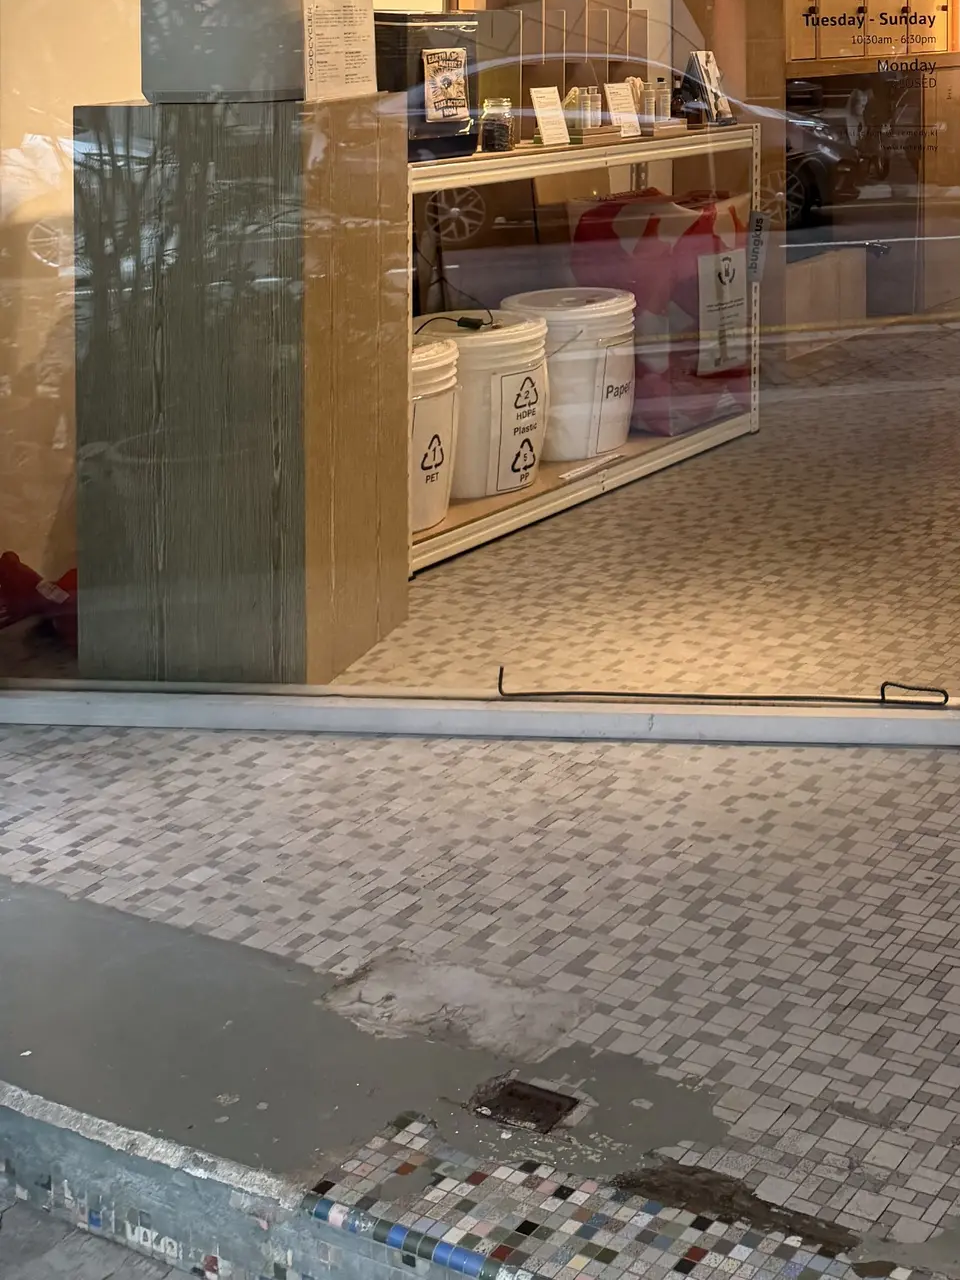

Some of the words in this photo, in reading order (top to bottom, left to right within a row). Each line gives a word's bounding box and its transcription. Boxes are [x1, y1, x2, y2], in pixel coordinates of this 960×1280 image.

[802, 13, 865, 29] Tuesday
[879, 12, 936, 28] Sunday
[851, 35, 892, 45] 10:30am
[900, 34, 937, 46] 6:30pm
[877, 58, 937, 74] Monday
[516, 408, 536, 420] HDPE
[513, 423, 538, 436] Plastic
[425, 472, 440, 484] PET
[519, 472, 530, 482] PP
